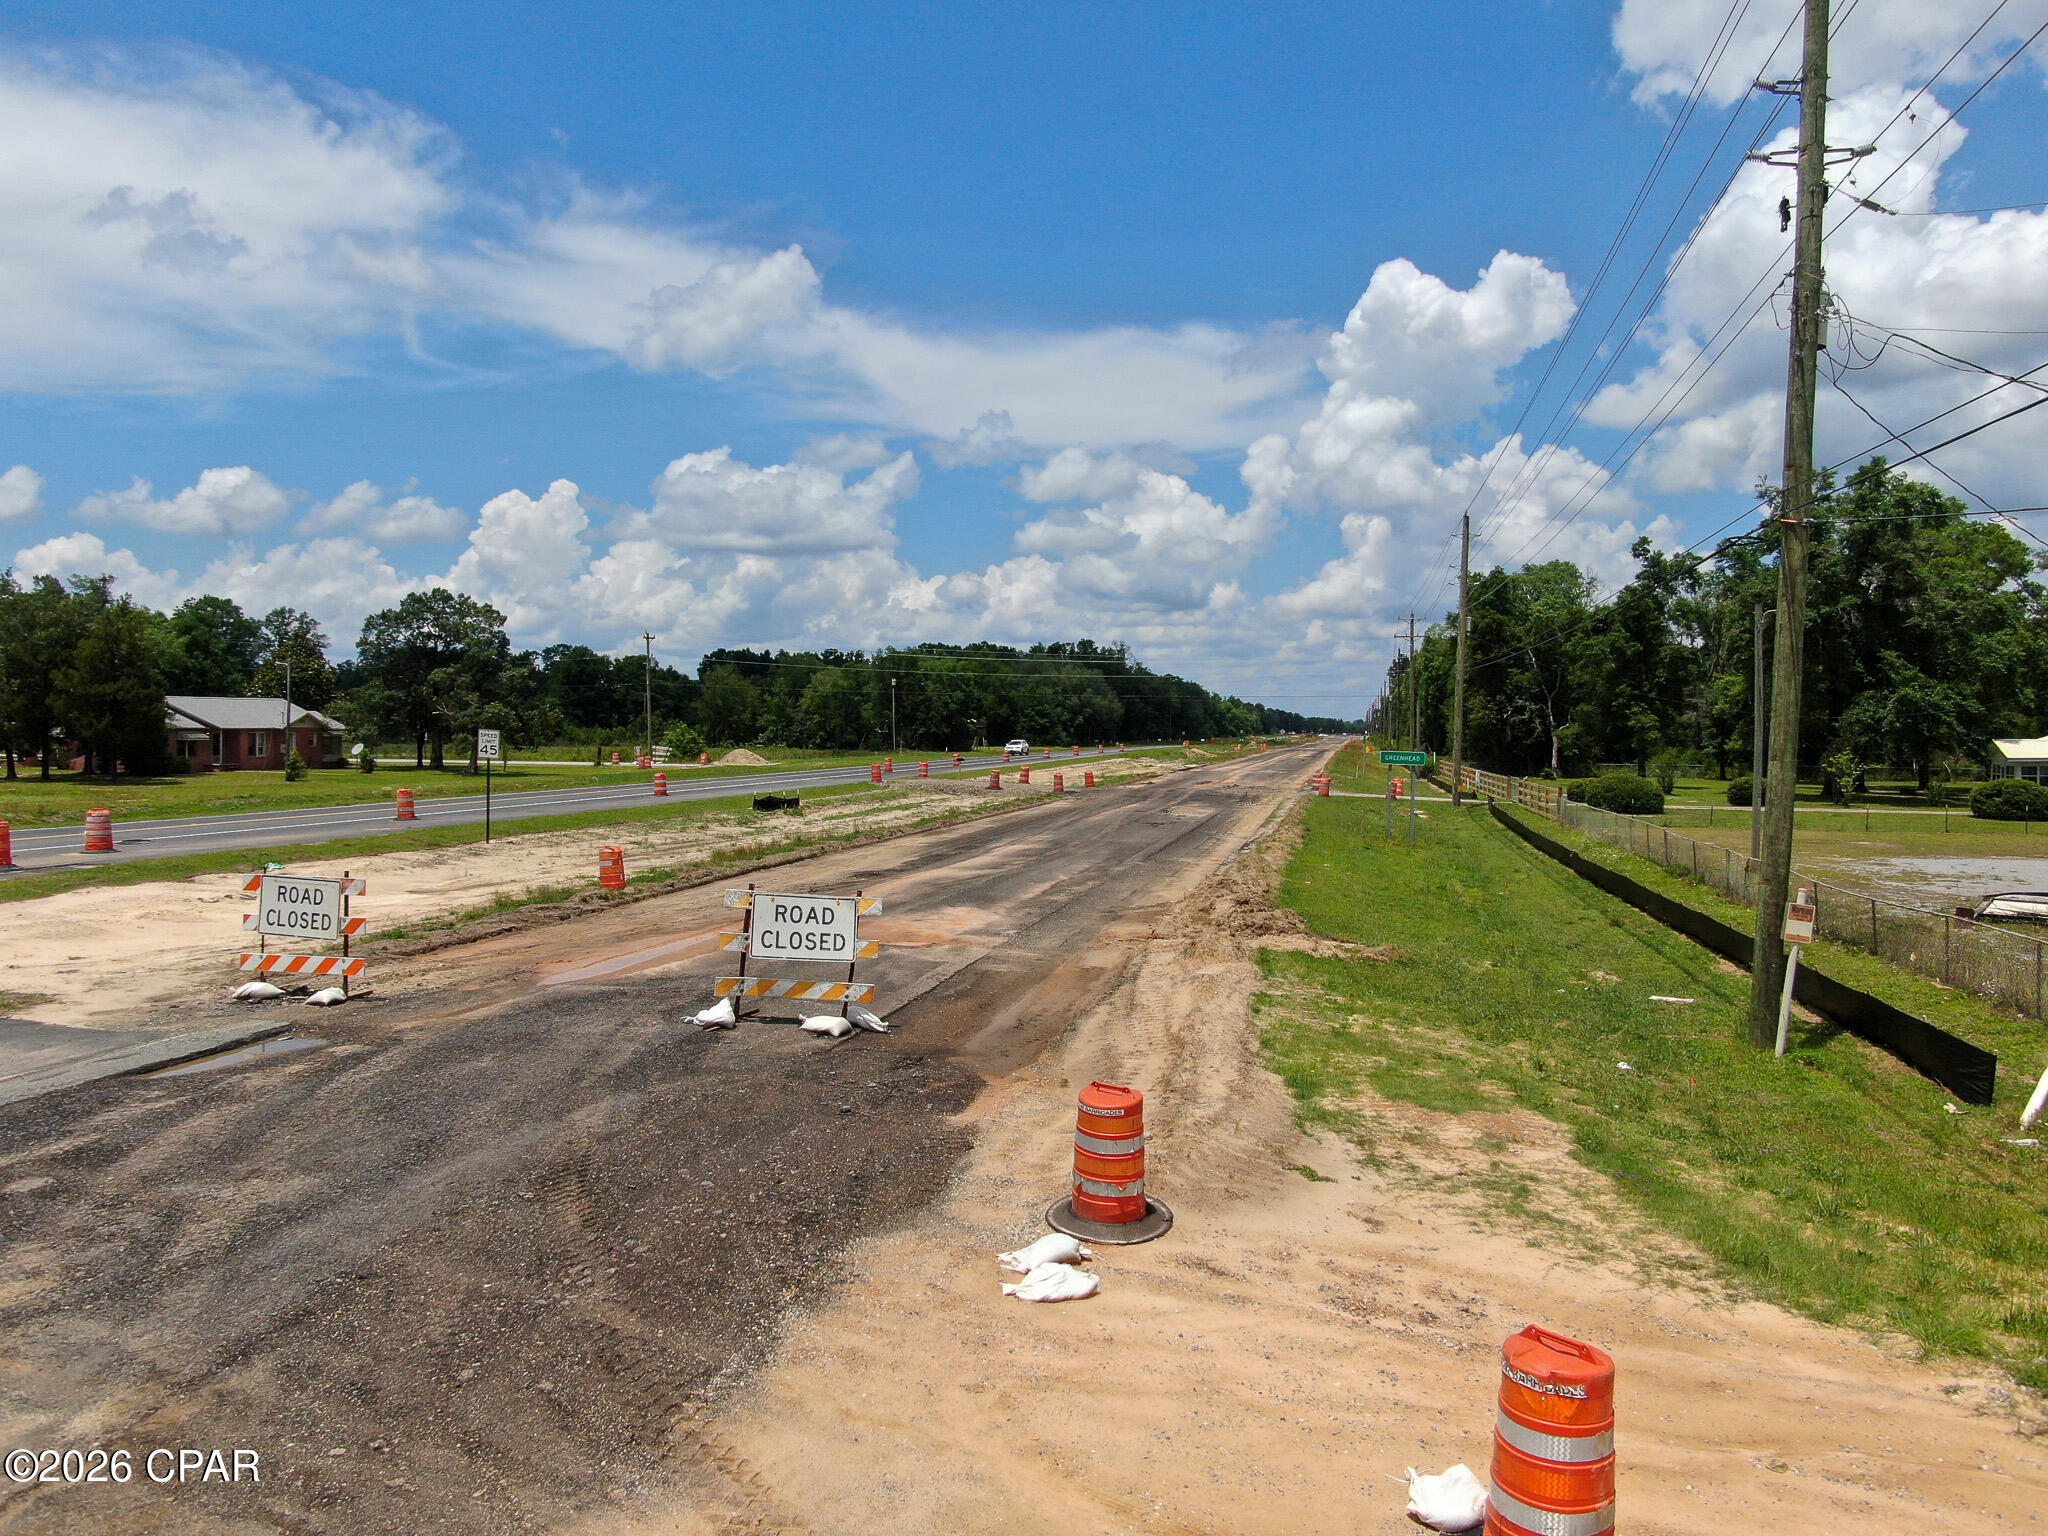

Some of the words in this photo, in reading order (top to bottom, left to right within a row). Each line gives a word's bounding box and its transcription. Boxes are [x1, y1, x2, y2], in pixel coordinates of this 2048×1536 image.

[480, 745, 498, 756] 45
[1384, 754, 1421, 762] GREENHEAD
[277, 885, 324, 906] ROAD
[266, 908, 332, 931] CLOSED
[774, 904, 835, 926] ROAD
[760, 929, 846, 952] CLOSED
